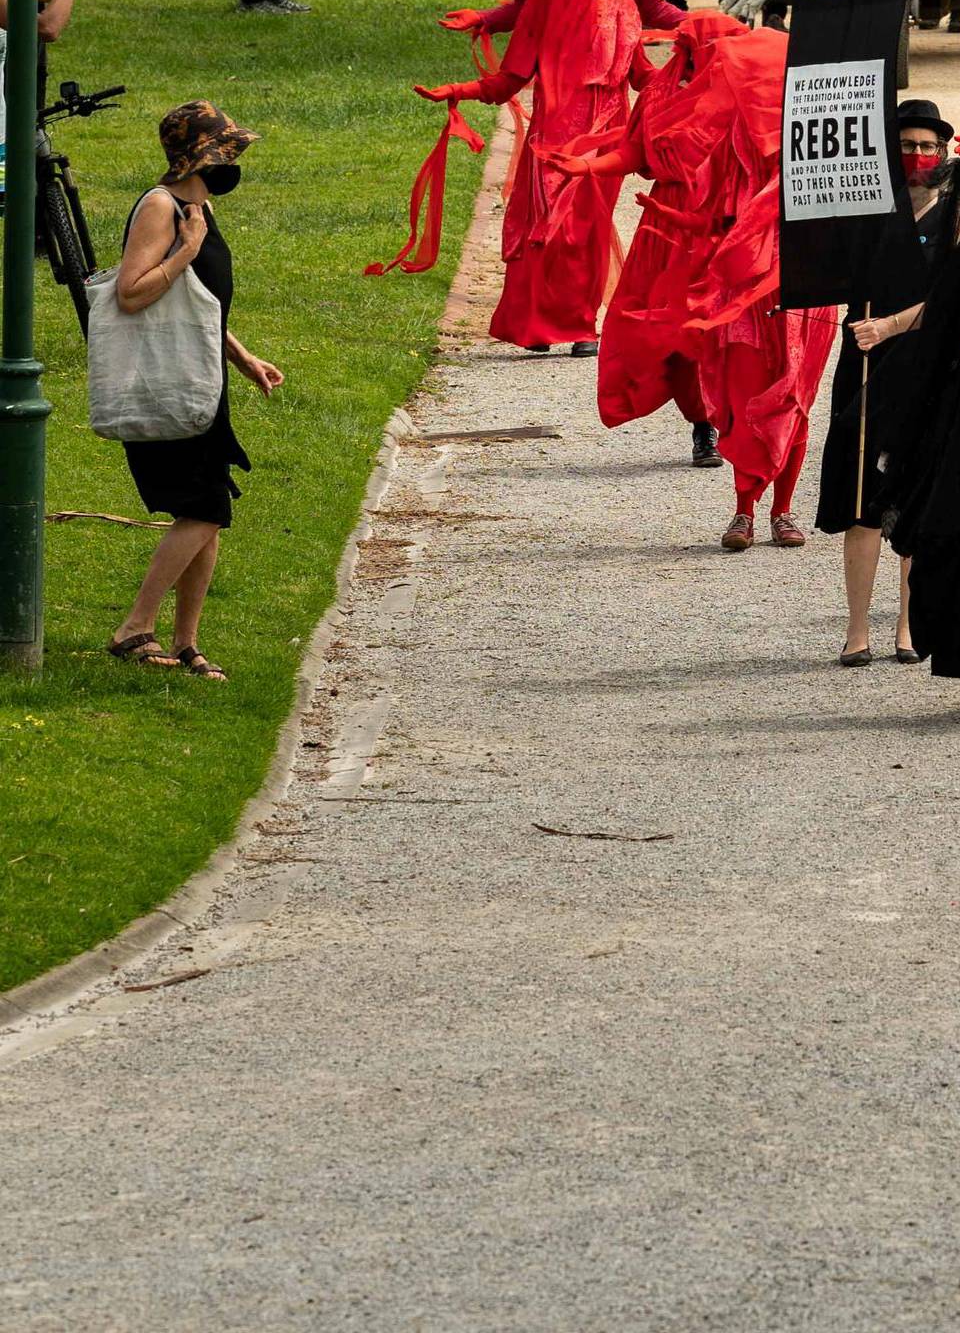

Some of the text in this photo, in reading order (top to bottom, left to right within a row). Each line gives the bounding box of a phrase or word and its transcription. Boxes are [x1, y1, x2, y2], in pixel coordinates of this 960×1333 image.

[795, 75, 876, 91] WE ACKNOWLEDGE
[794, 90, 875, 103] THE TRADITIONAL OWNERS
[811, 105, 827, 113] LAND
[829, 104, 838, 112] ON
[841, 103, 863, 111] WHICH
[791, 115, 877, 162] REBEL
[792, 161, 879, 175] AND PAY OUR RESPECTS
[792, 173, 880, 191] TO THEIR ELDERS
[793, 189, 882, 206] PAST AND PRESENT
